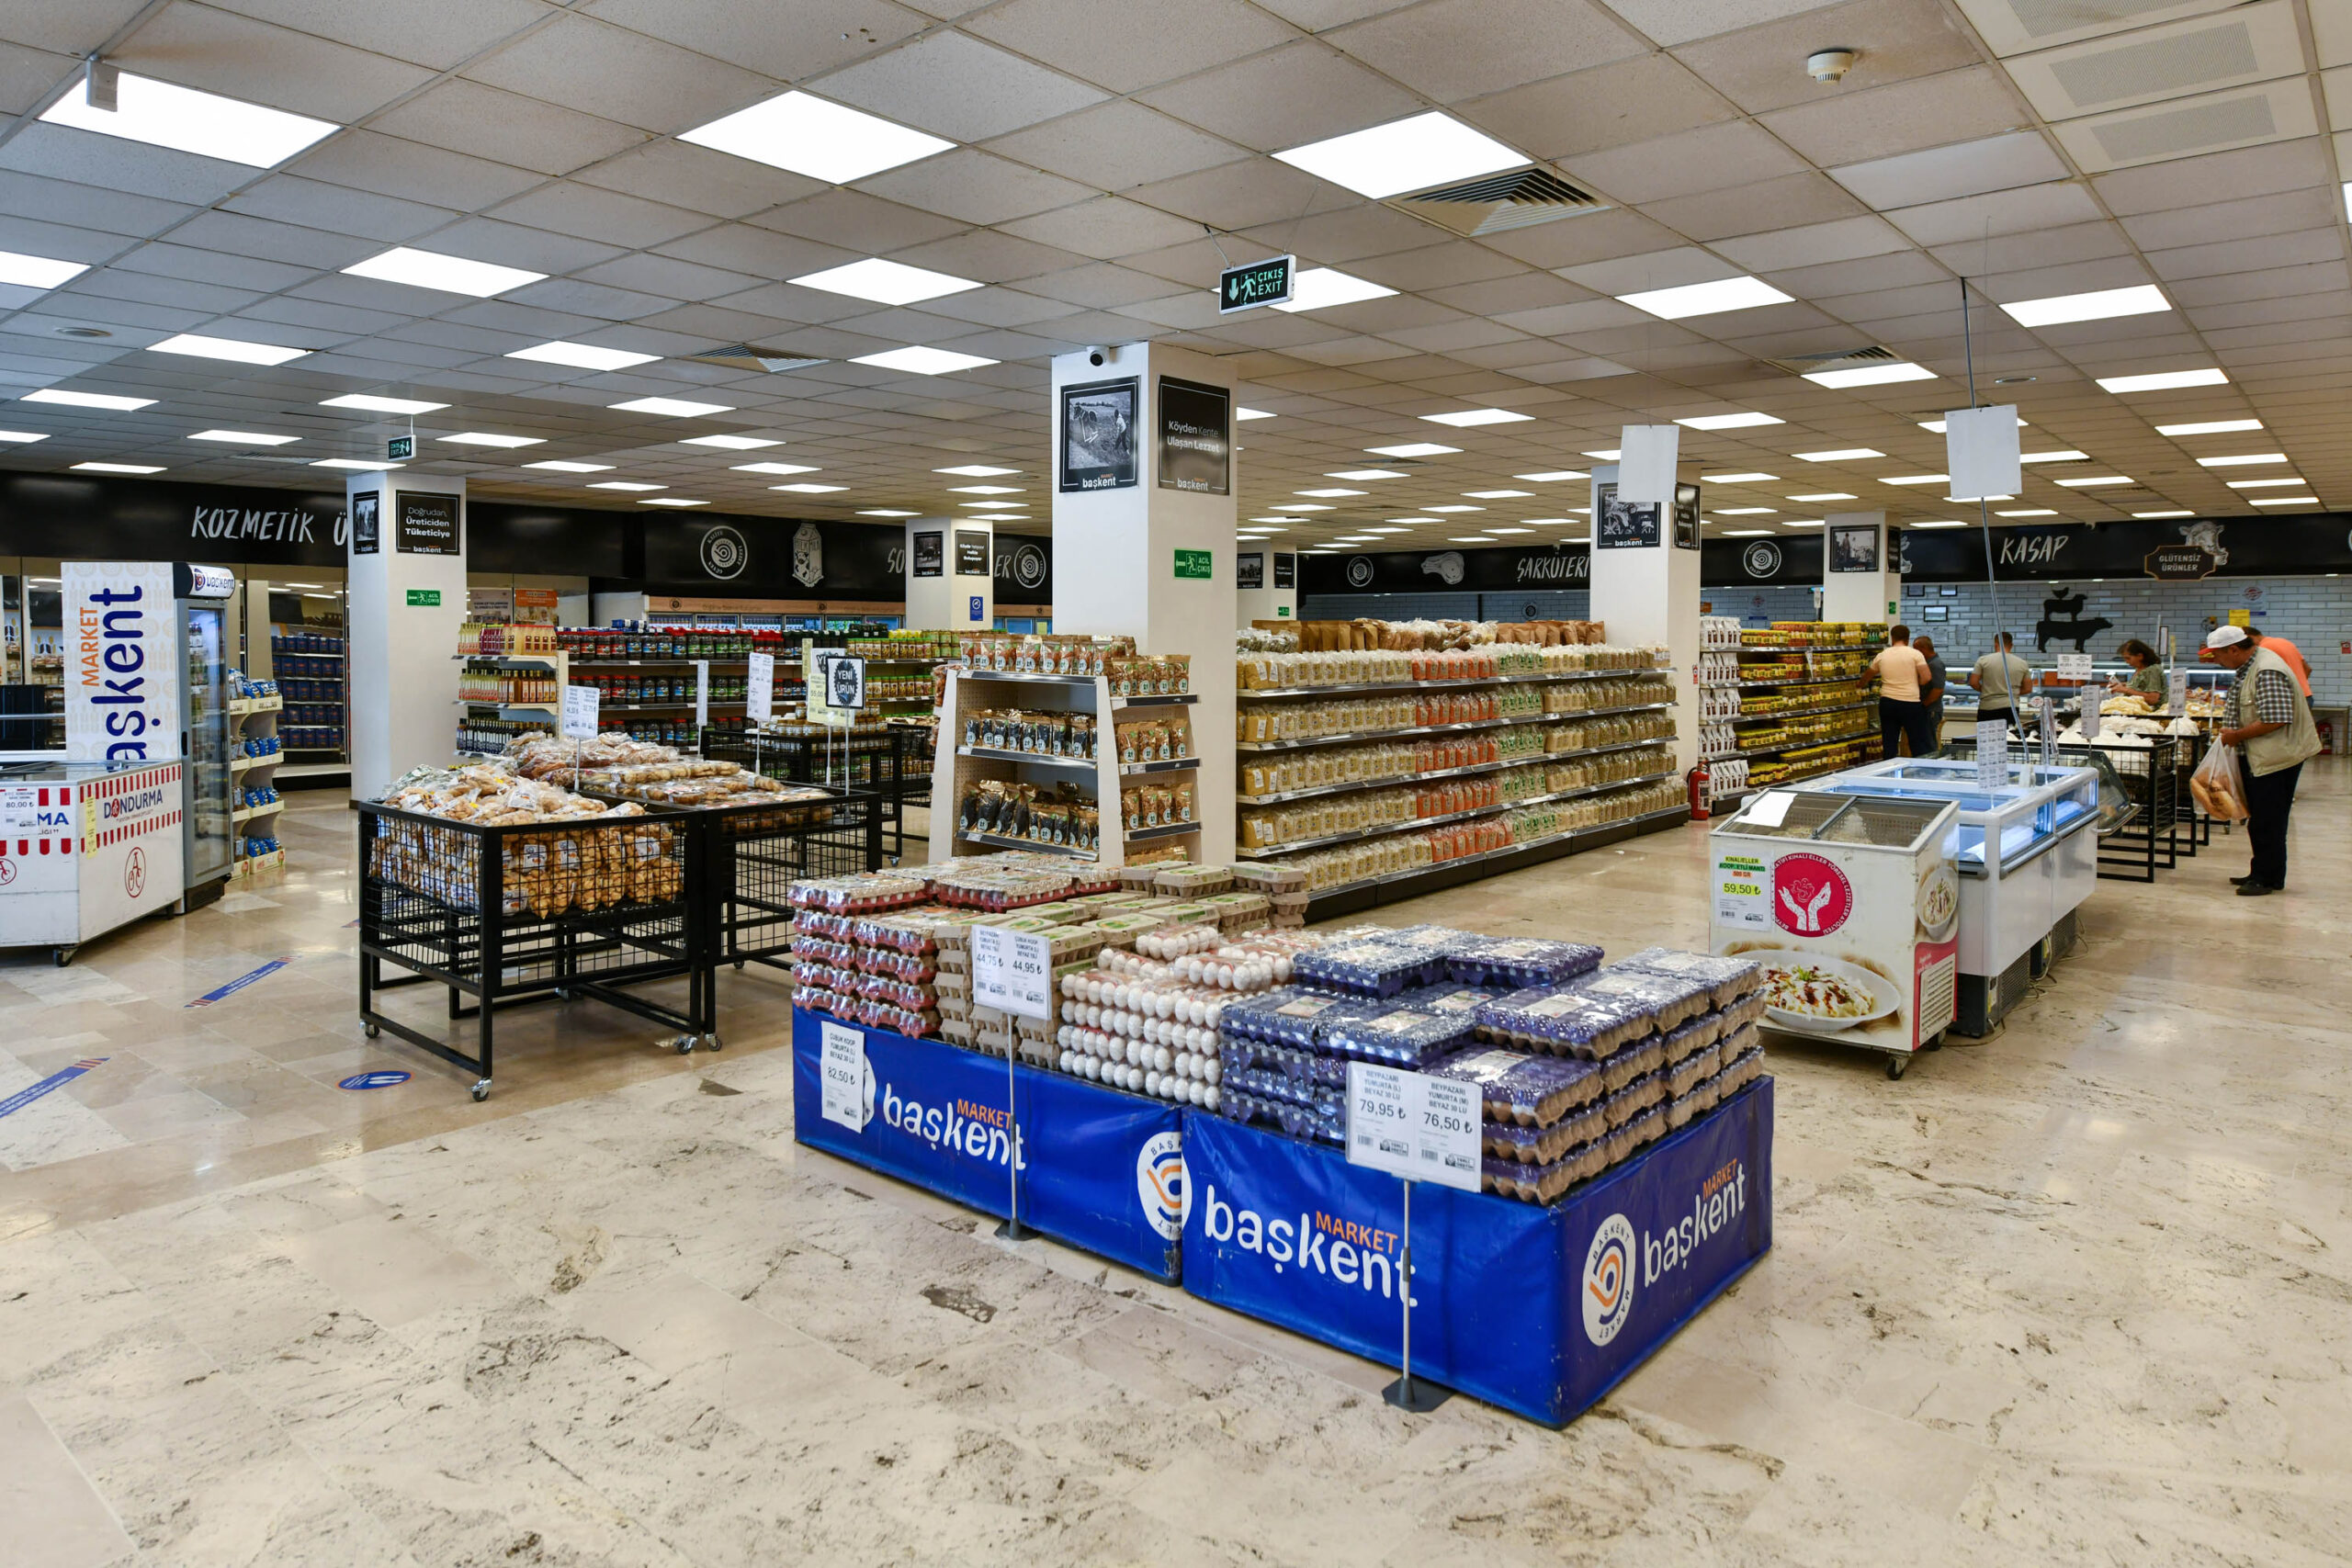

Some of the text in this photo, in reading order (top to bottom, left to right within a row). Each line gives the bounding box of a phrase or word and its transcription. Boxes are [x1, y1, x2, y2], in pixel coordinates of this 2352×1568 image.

[1258, 267, 1283, 284] ÇIKIŞ
[1258, 280, 1283, 296] EXIT
[1168, 420, 1219, 437] Köyden Kente
[1167, 436, 1220, 454] Ulaşan Lezzet
[1082, 477, 1116, 490] başkent
[1177, 478, 1209, 491] başkent
[408, 506, 447, 517] Doğrudan,
[191, 505, 314, 544] KOZMETİK
[406, 516, 449, 527] Üreticiden
[405, 527, 450, 538] Tüketiciye
[2000, 536, 2068, 564] KASAP
[1198, 556, 1210, 565] ACİL
[2158, 553, 2201, 563] GLÜTENSİZ
[1197, 564, 1211, 574] ÇIKIŞ
[1517, 552, 1590, 582] ŞARKÜTERİ
[2161, 562, 2199, 571] ÜRÜNLER
[80, 606, 99, 687] MARKET
[89, 585, 161, 767] aşkent
[838, 668, 854, 680] YENİ
[837, 682, 854, 694] ÜRÜN
[1724, 883, 1751, 895] 59,50
[977, 953, 997, 966] 44,75
[1012, 959, 1035, 974] 44,95
[1366, 1070, 1399, 1082] BEYPAZARI
[1364, 1078, 1392, 1090] YUMURTA
[1430, 1082, 1466, 1096] BEYPAZARI
[1364, 1088, 1384, 1098] BEYAZ
[1428, 1091, 1469, 1106] YUMURTA (M)
[1360, 1099, 1395, 1118] 79,95
[1429, 1100, 1450, 1111] BEYAZ
[956, 1098, 1011, 1131] MARKET
[1424, 1111, 1461, 1132] 76,50
[883, 1082, 1026, 1170] başkent
[1702, 1157, 1737, 1201] MARKET
[1316, 1210, 1398, 1255] MARKET
[1644, 1163, 1746, 1288] başkent
[1204, 1184, 1419, 1308] başkent
